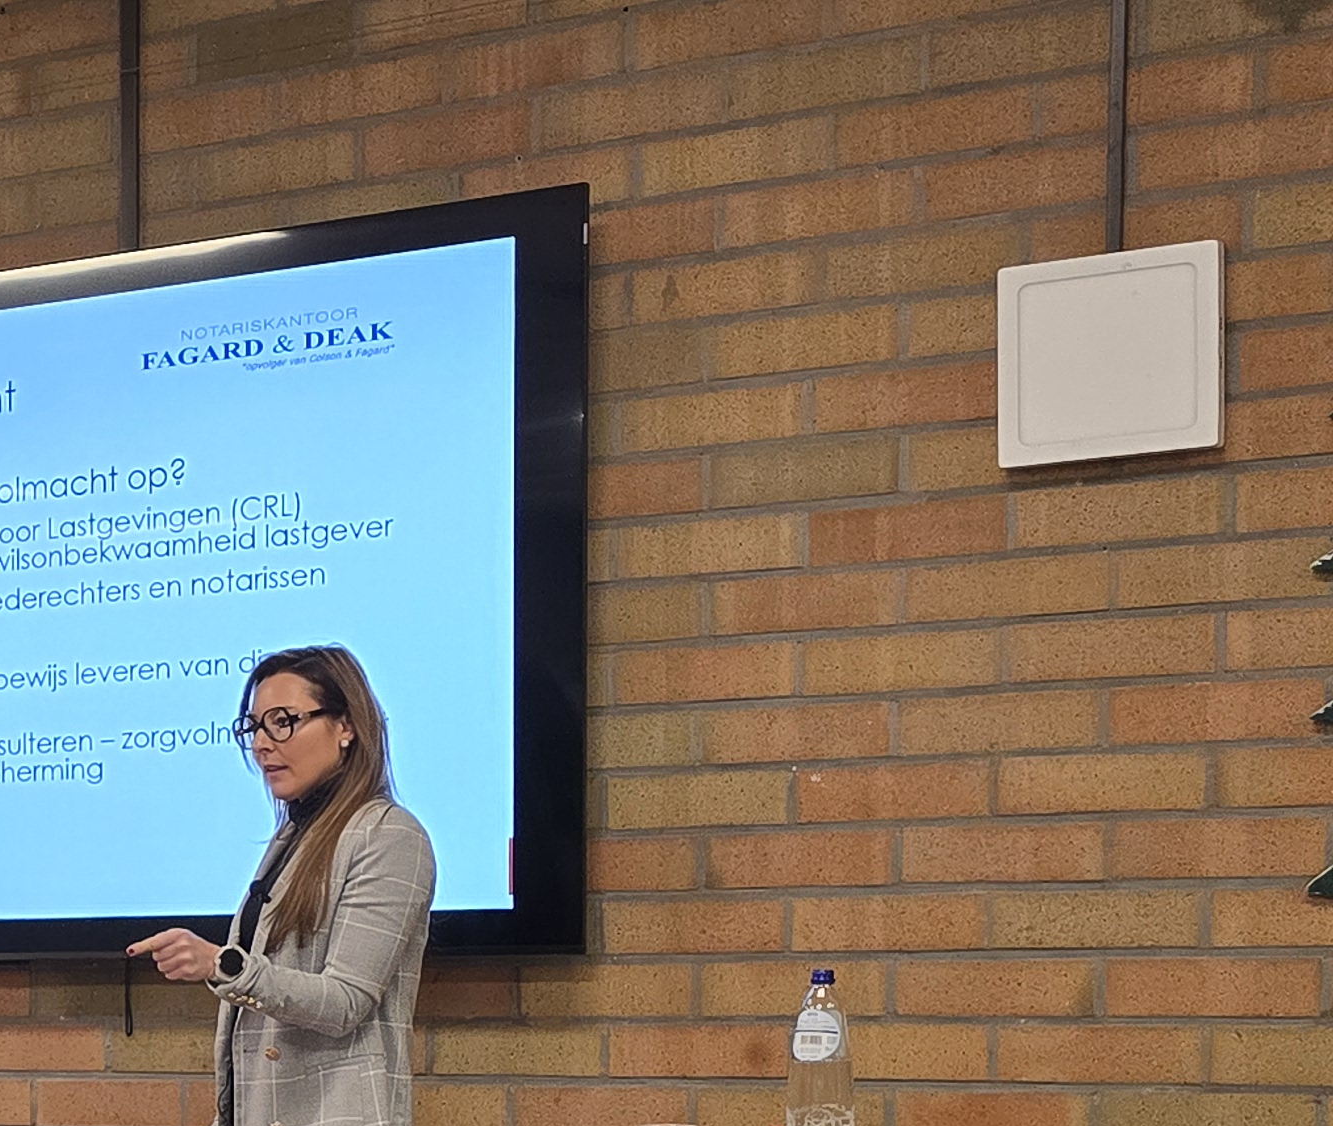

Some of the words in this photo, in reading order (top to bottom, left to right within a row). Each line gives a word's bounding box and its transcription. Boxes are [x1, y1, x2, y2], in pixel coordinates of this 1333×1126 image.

[181, 307, 358, 341] NOTARISKANTOOR
[143, 340, 264, 370] FAGARD
[272, 335, 294, 354] &
[304, 321, 392, 350] DEAK
[128, 458, 184, 494] op?
[47, 504, 221, 540] Lastgevingen
[232, 491, 301, 526] (CRL)
[265, 516, 395, 549] lastgever
[150, 581, 181, 598] en
[192, 566, 325, 595] notarissen
[76, 662, 170, 685] leveren
[180, 658, 228, 676] van
